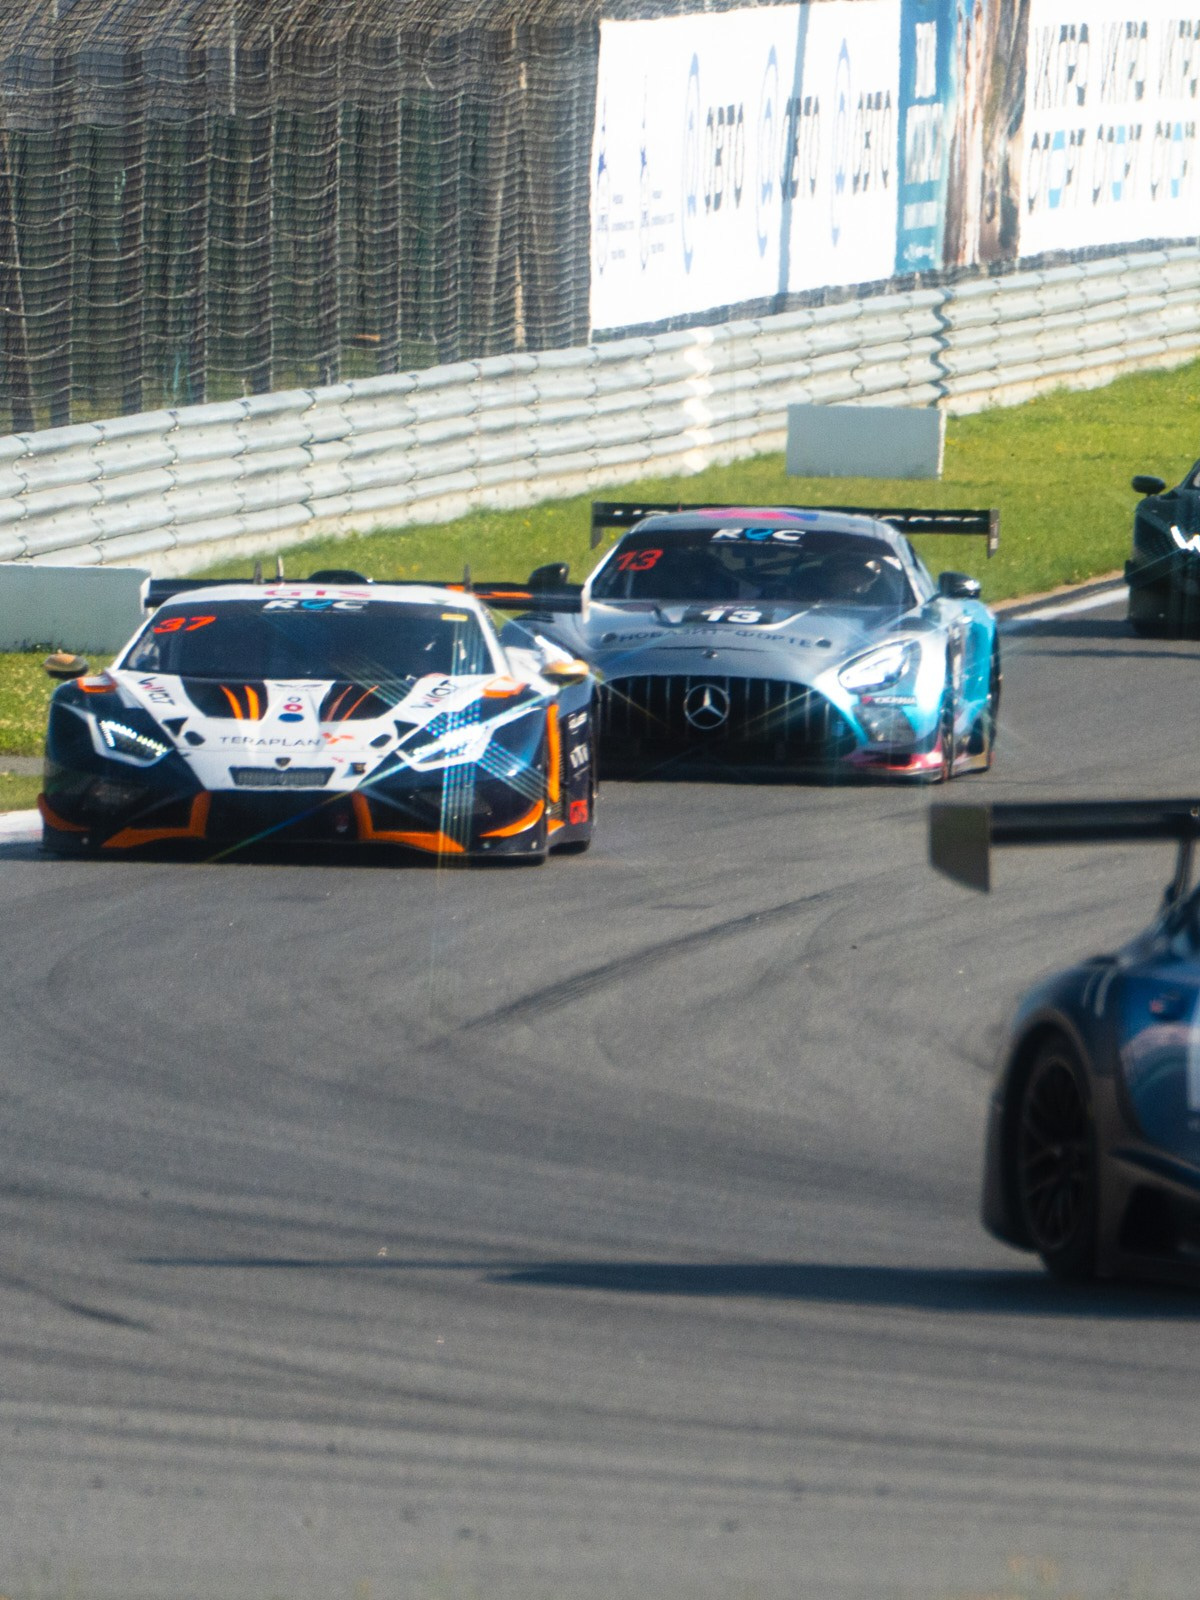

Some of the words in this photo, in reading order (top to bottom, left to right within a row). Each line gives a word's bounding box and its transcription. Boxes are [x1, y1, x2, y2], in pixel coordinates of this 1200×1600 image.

[617, 549, 664, 571] 13
[701, 610, 763, 623] 13
[153, 615, 217, 635] 37
[219, 736, 321, 747] TERAPLAN
